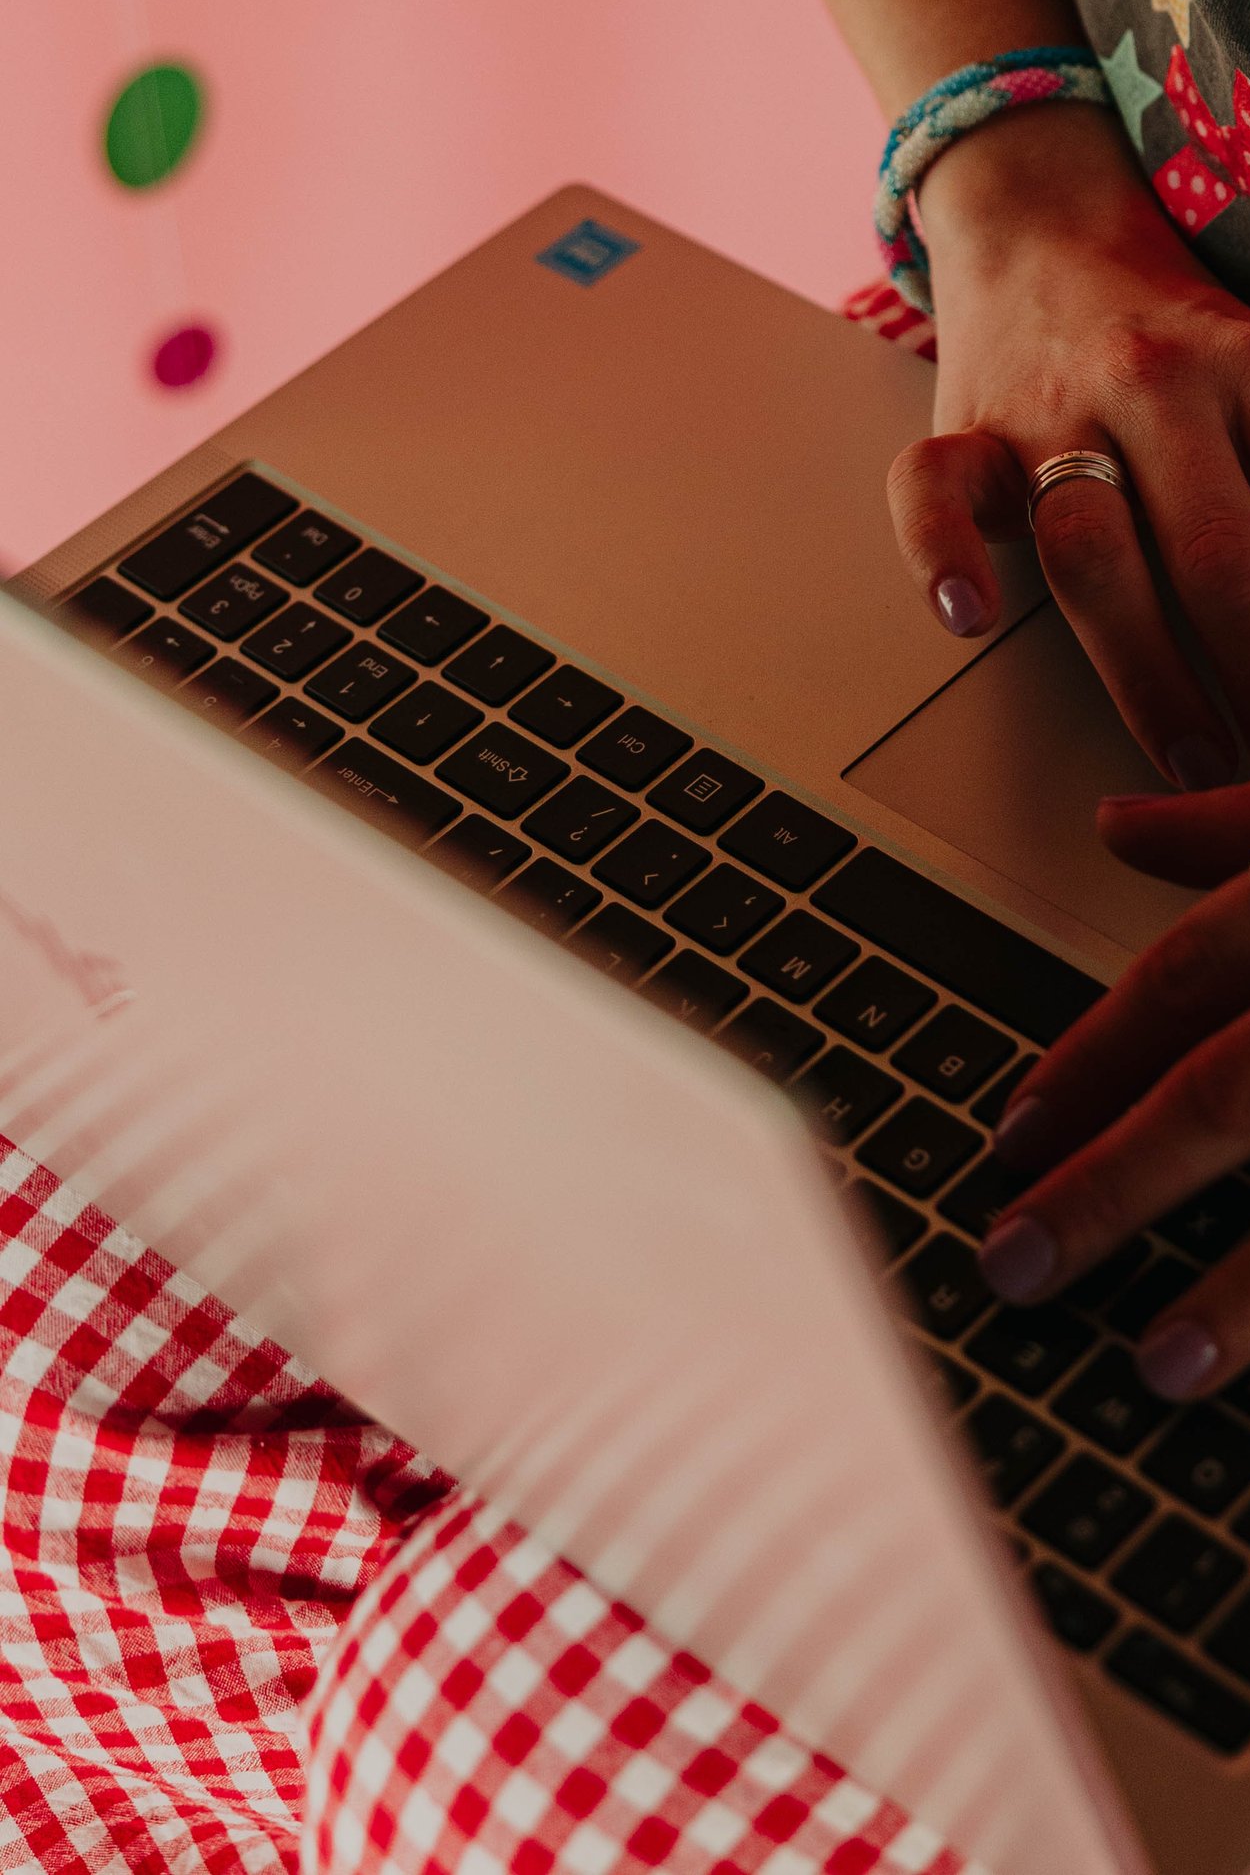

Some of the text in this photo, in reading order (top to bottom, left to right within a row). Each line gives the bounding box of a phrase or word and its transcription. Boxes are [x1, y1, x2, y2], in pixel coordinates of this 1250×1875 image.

[187, 525, 221, 550] Enter
[302, 525, 329, 546] Del
[229, 573, 265, 600] PgDn
[344, 586, 363, 603] 0
[211, 599, 230, 615] 3
[272, 638, 292, 655] 2
[358, 657, 389, 679] End
[338, 681, 356, 697] 1
[617, 733, 646, 753] Ctrl
[477, 747, 511, 772] Shift
[338, 765, 375, 796] Enter
[569, 826, 589, 843] ?
[773, 826, 799, 845] Alt
[779, 956, 813, 980] M
[857, 1004, 888, 1029] N
[938, 1055, 966, 1077] B
[821, 1095, 852, 1118] H
[903, 1148, 931, 1171] G
